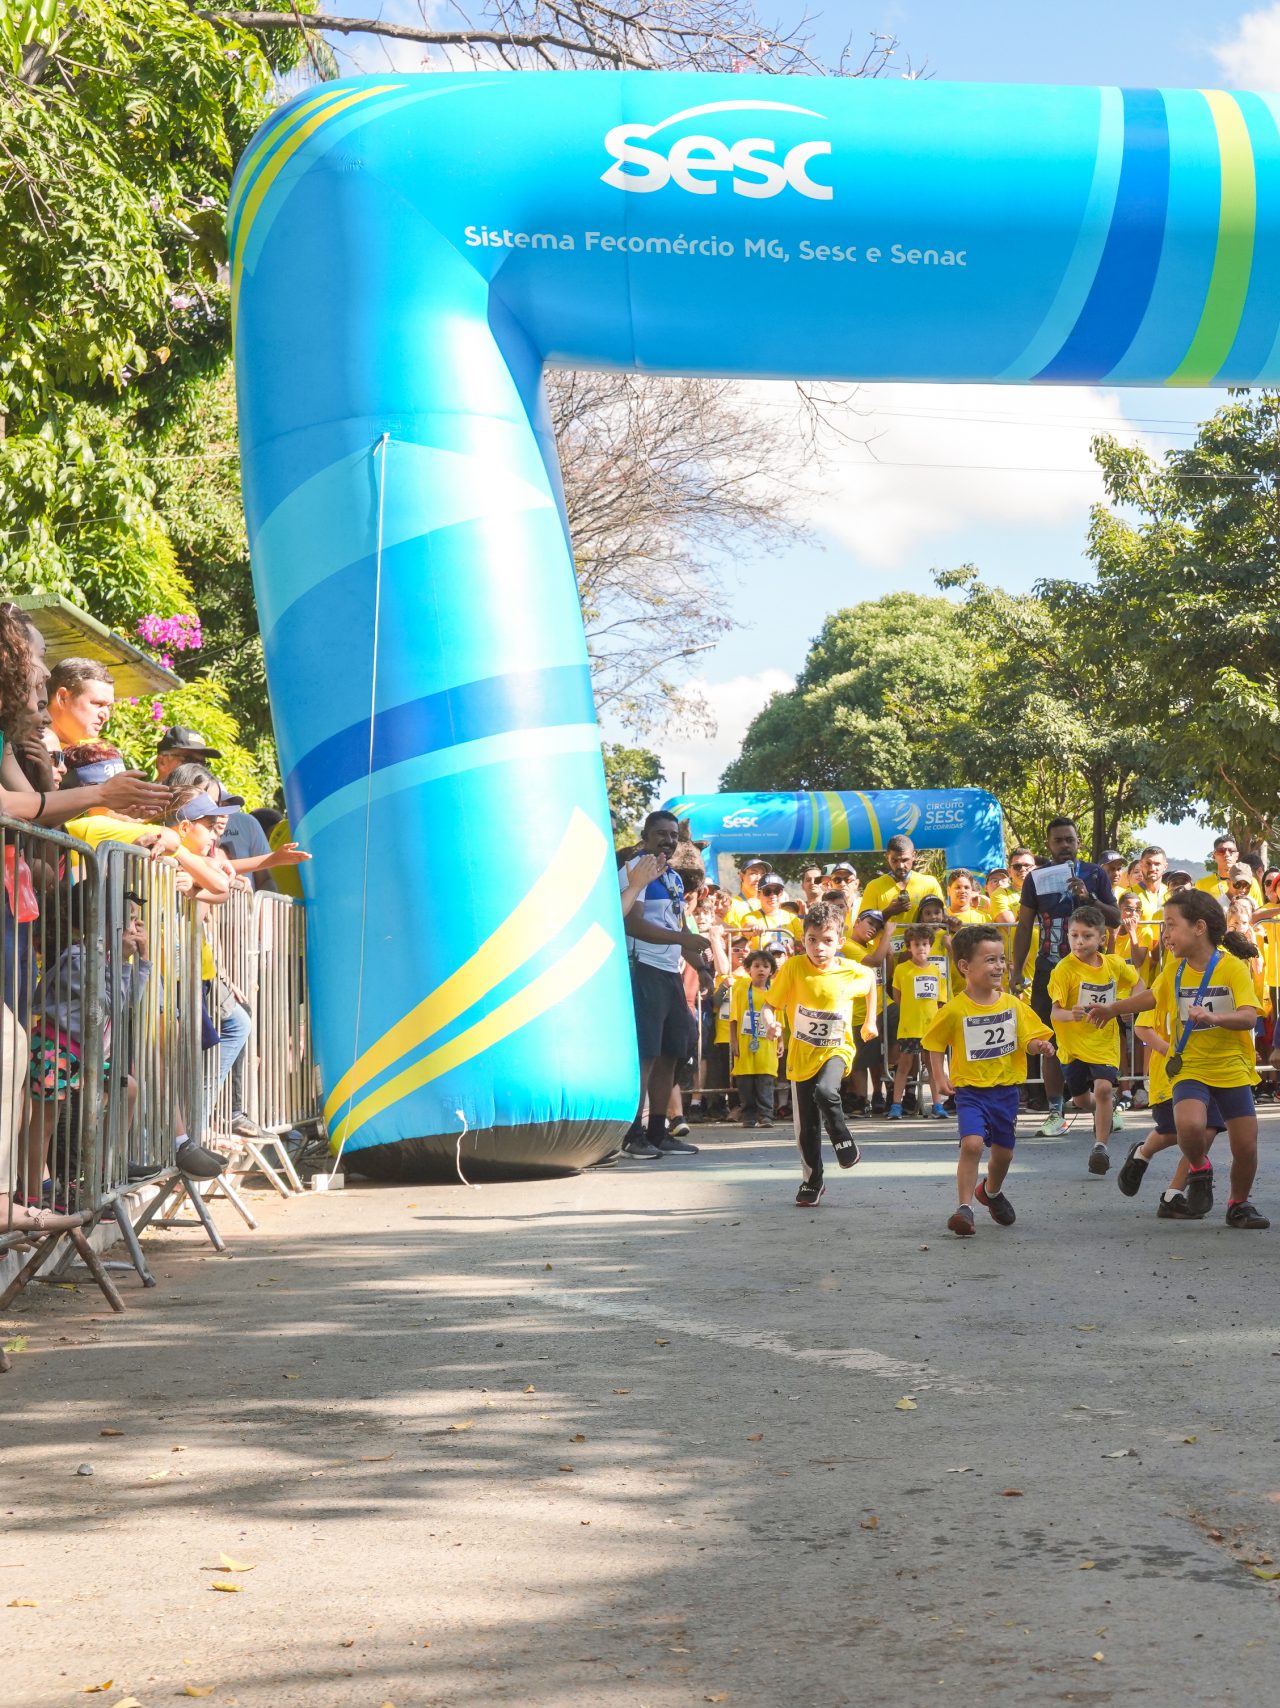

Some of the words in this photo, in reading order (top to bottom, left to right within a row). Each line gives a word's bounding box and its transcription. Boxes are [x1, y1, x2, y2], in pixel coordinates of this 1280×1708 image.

[599, 121, 834, 201] Sesc
[464, 225, 576, 251] Sistema
[584, 231, 735, 258] Fecomércio
[744, 237, 791, 264] MG,
[799, 241, 858, 263] Sesc
[866, 248, 883, 264] e
[891, 244, 968, 267] Senac
[925, 809, 965, 825] SESC
[924, 982, 935, 992] 50
[808, 1021, 829, 1037] 23
[983, 1026, 1006, 1046] 22
